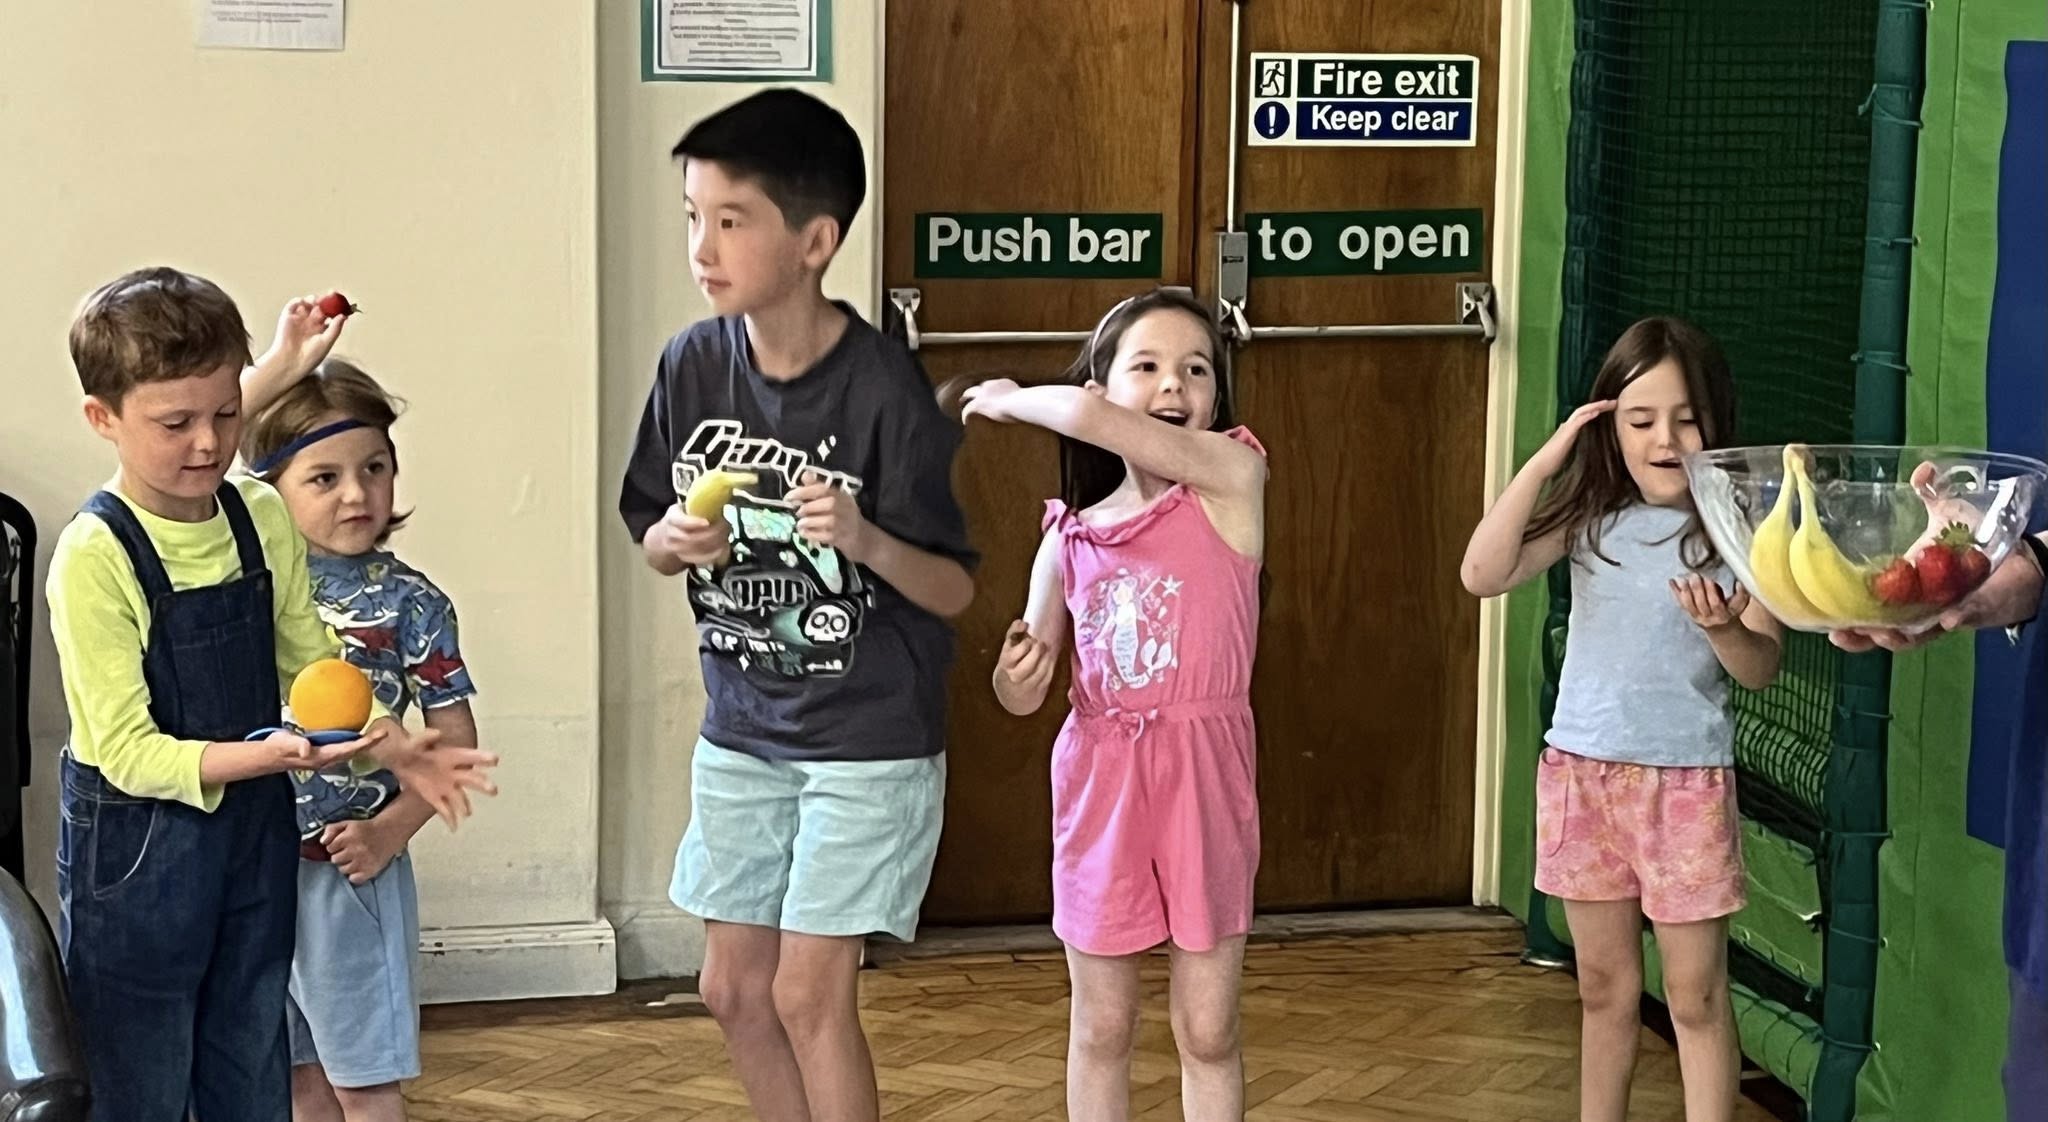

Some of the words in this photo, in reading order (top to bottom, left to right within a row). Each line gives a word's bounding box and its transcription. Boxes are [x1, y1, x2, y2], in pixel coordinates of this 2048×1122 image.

[1313, 62, 1382, 95] Fire
[1394, 63, 1460, 95] exit
[1311, 104, 1382, 137] Keep
[1391, 104, 1460, 131] clear
[929, 216, 1051, 263] Push
[1068, 216, 1151, 263] bar
[1257, 218, 1313, 261] to
[1338, 222, 1470, 270] open
